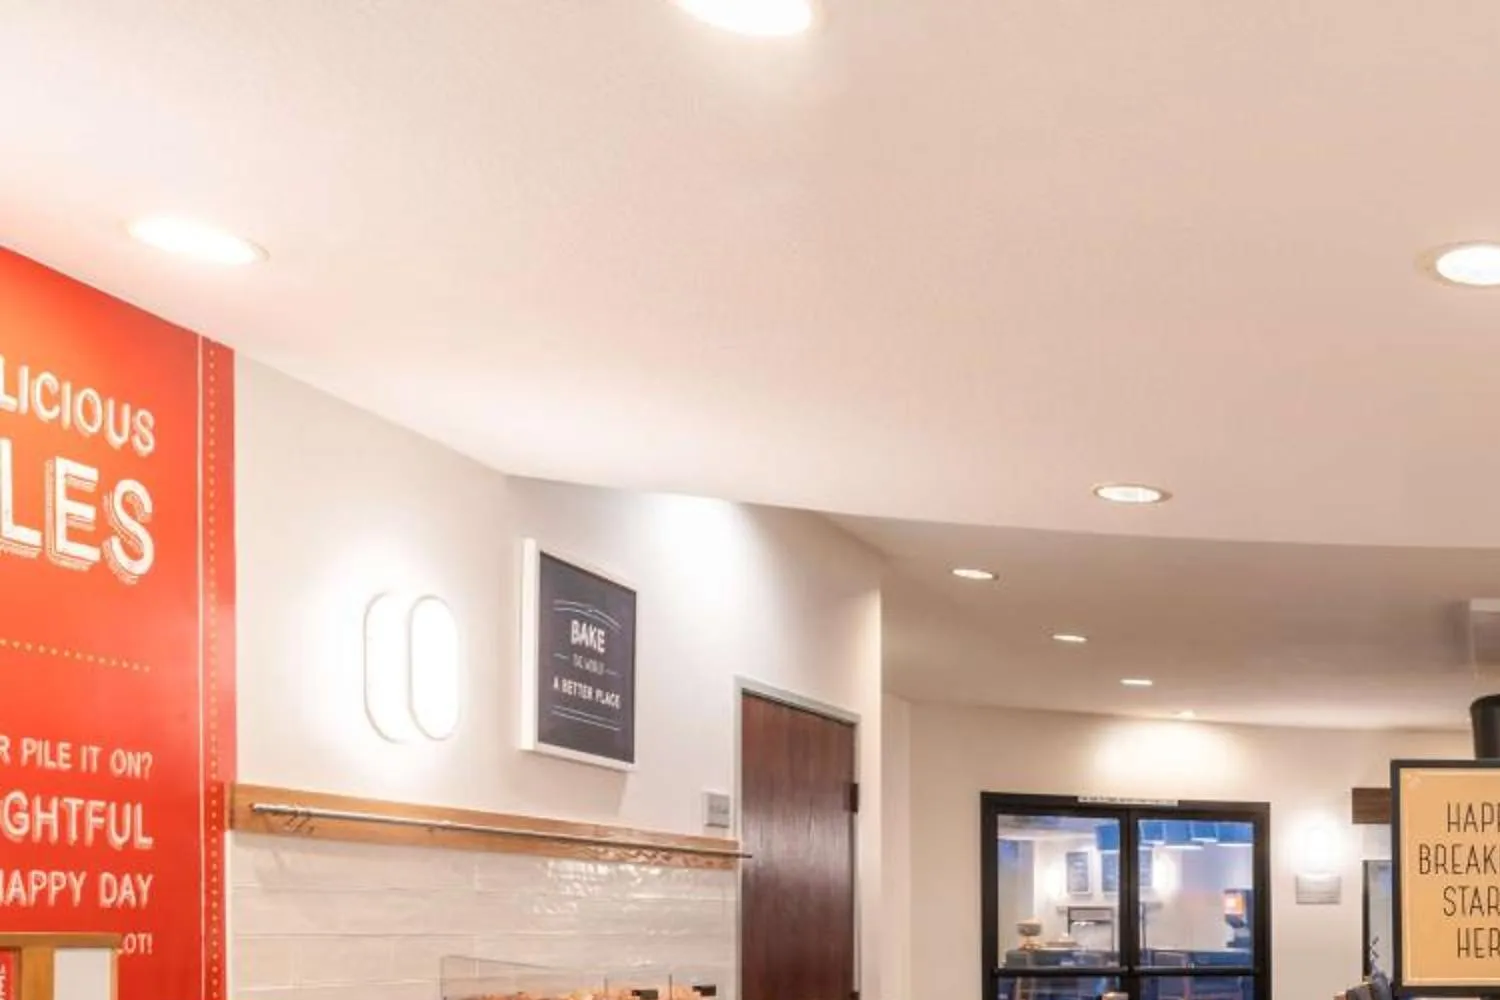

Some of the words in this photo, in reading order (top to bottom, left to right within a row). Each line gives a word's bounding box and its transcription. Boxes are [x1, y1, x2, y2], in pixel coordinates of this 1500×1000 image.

[571, 620, 606, 653] BAKE
[561, 678, 593, 700] BETTER
[20, 738, 71, 771] PILE
[80, 746, 101, 772] IT
[110, 748, 153, 779] ON?
[99, 872, 153, 908] DAY
[115, 932, 153, 955] OT!
